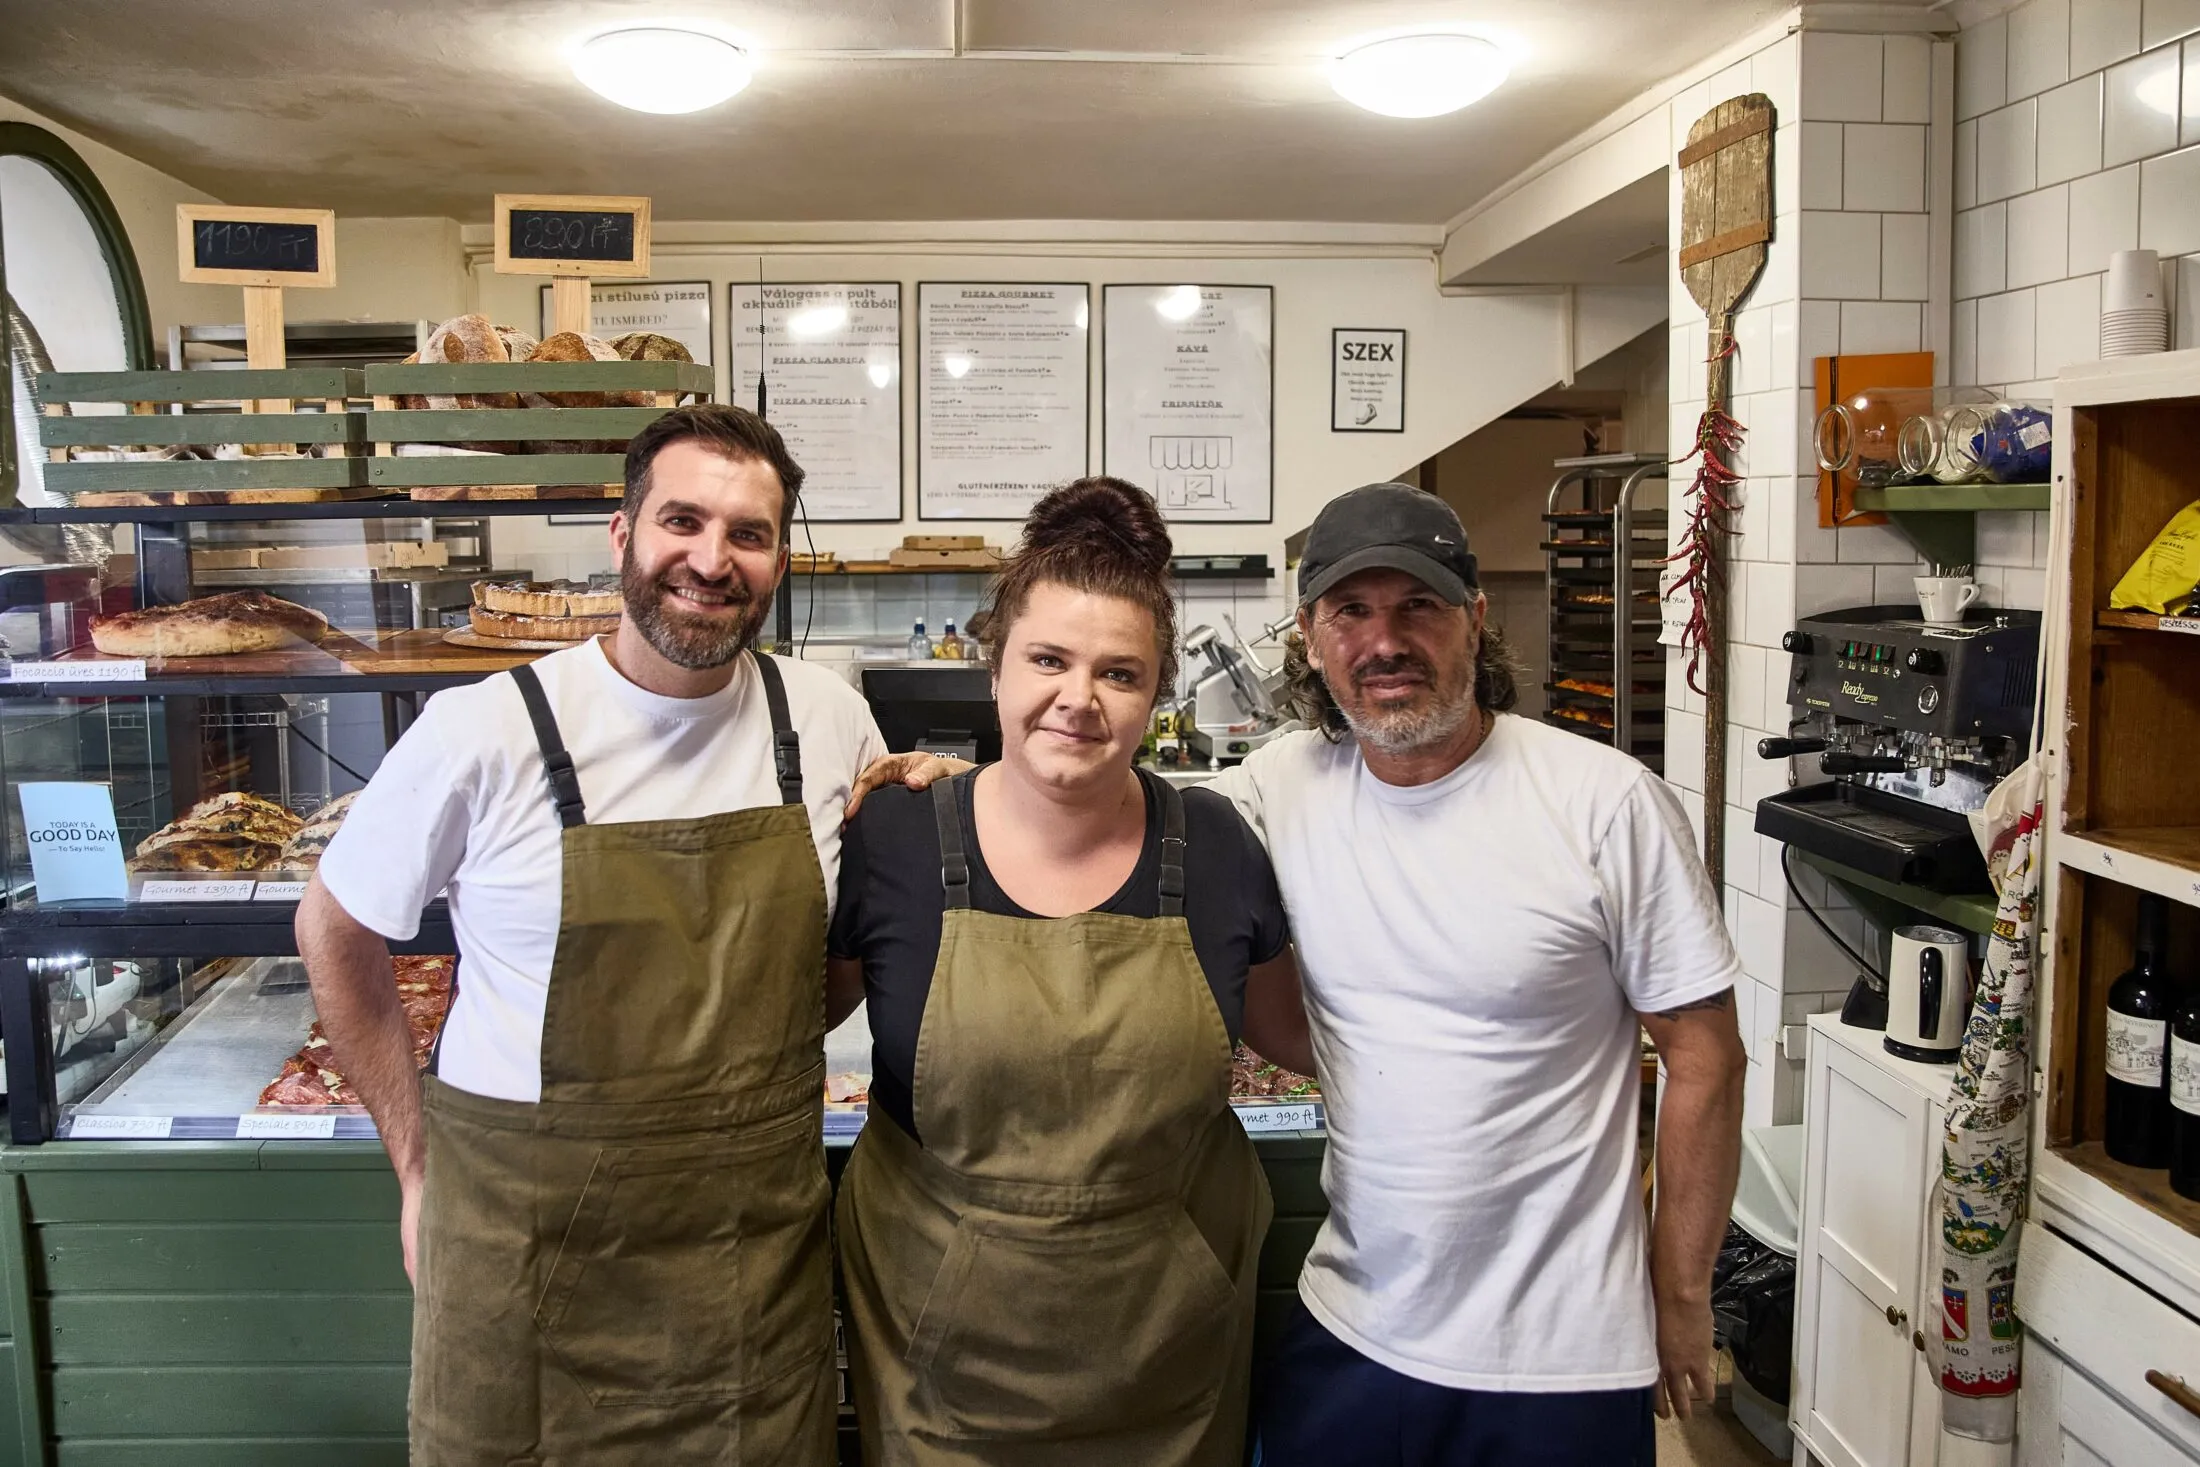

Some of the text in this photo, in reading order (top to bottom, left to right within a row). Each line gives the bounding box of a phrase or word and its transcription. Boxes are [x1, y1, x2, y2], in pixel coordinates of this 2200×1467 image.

[199, 223, 271, 255] 1190
[664, 291, 705, 303] pizza
[763, 288, 830, 300] Válogass
[848, 288, 876, 300] pult
[961, 291, 1055, 299] PIZZA GOURMET
[611, 315, 667, 326] ISMERED?
[1176, 344, 1209, 353] KÁVÉ
[1342, 342, 1394, 362] SZEX
[773, 357, 866, 365] PIZZA CLASSICA
[14, 665, 65, 678] Focaccia
[99, 666, 128, 681] 1190
[132, 665, 144, 680] ft
[50, 821, 79, 829] TODAY
[30, 829, 115, 842] GOOD DAY
[145, 884, 249, 896] Gourmet 1390 ft
[1273, 1112, 1299, 1126] 990
[1302, 1109, 1314, 1125] ft
[242, 1118, 289, 1132] Speciale
[319, 1118, 330, 1134] ft
